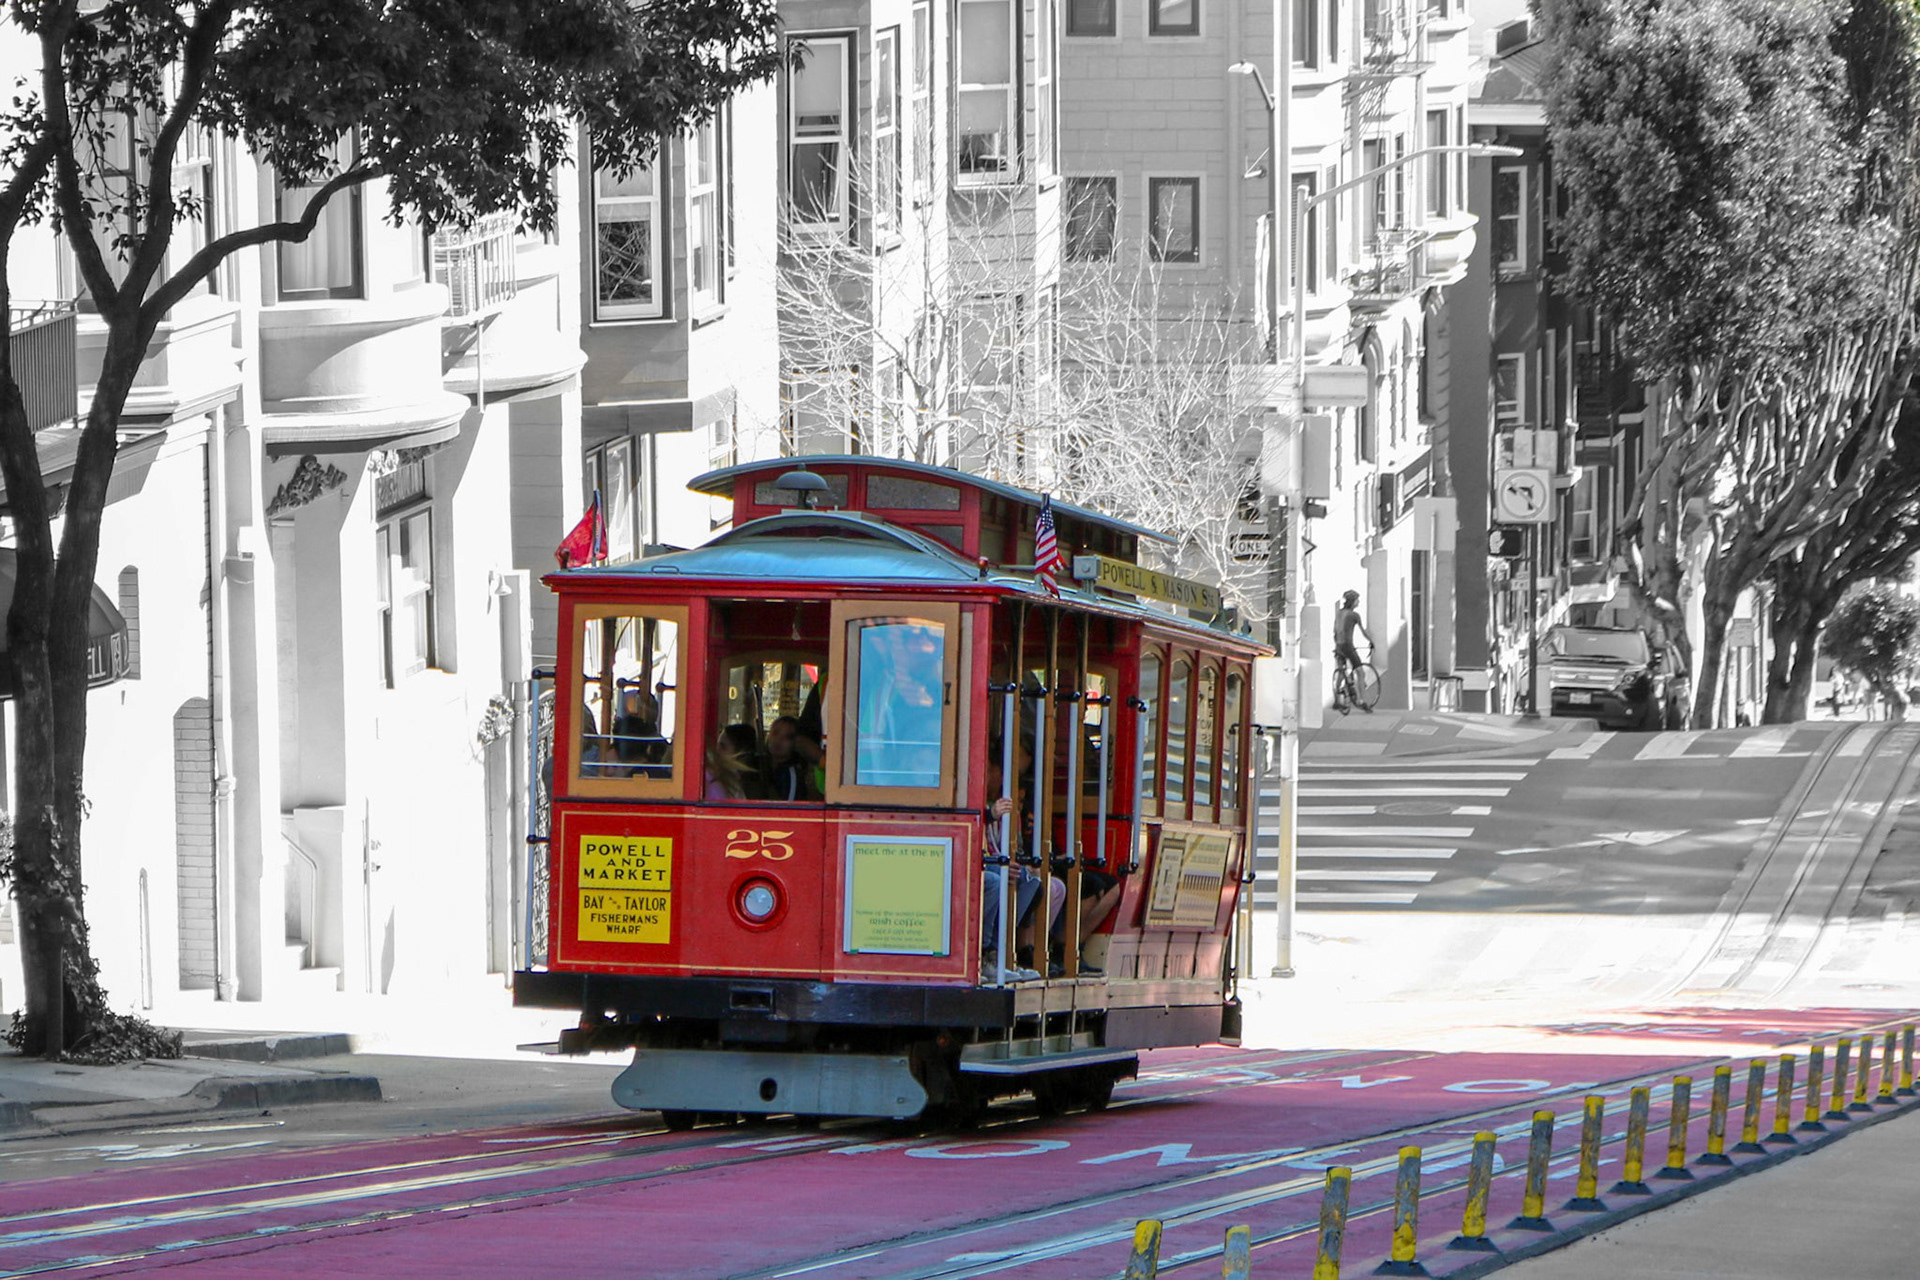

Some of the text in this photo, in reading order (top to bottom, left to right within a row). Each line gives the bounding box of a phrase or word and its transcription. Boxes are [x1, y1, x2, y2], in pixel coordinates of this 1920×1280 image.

[1102, 562, 1146, 590] POWELL
[1163, 578, 1198, 604] MASON
[586, 844, 666, 858] POWELL
[725, 829, 794, 861] 25
[607, 858, 647, 868] AND
[584, 868, 667, 881] MARKET
[584, 895, 604, 909] BAY
[624, 896, 667, 911] TAYLOR
[590, 912, 659, 925] FISHERMANS
[606, 925, 642, 935] WHARF
